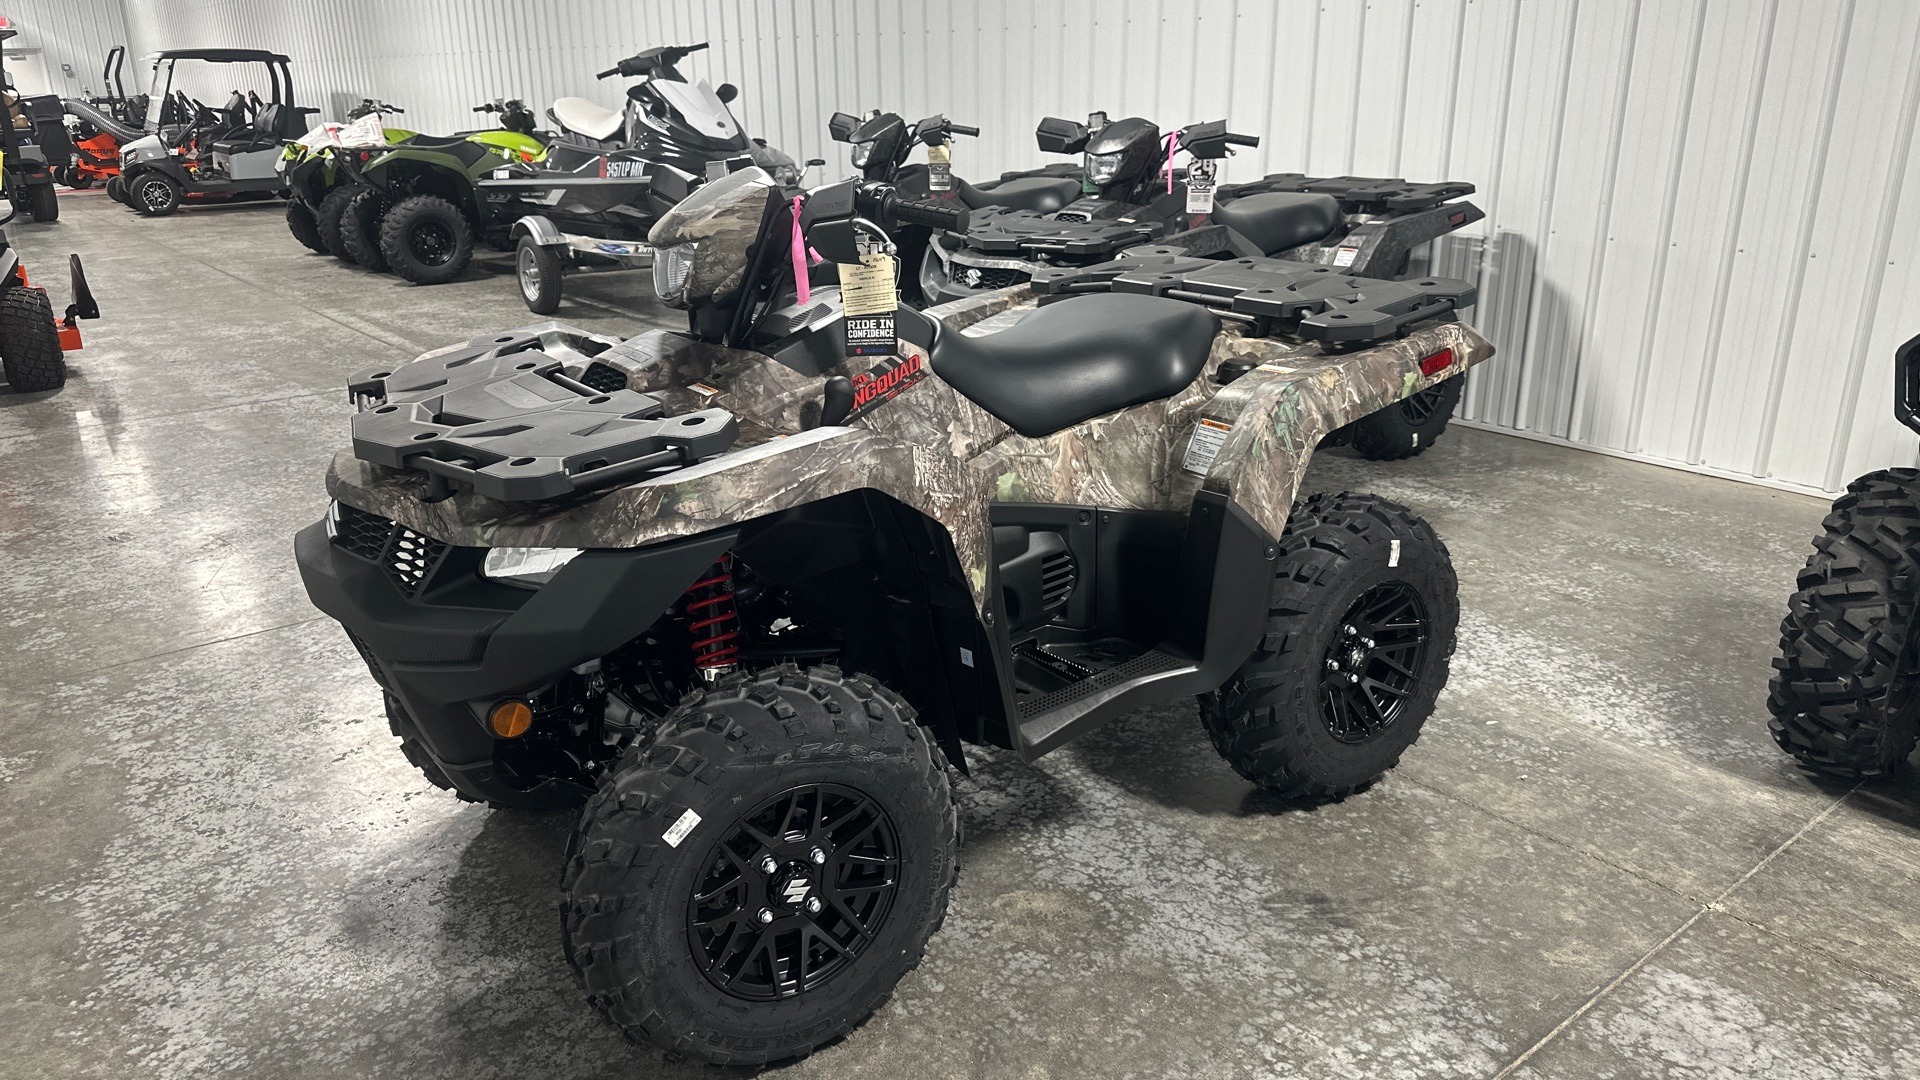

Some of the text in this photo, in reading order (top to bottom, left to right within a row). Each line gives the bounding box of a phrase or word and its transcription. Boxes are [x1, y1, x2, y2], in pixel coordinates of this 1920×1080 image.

[847, 319, 894, 329] RIDE IN
[847, 329, 895, 338] CONFIDENCE
[853, 354, 921, 409] NGQUAD
